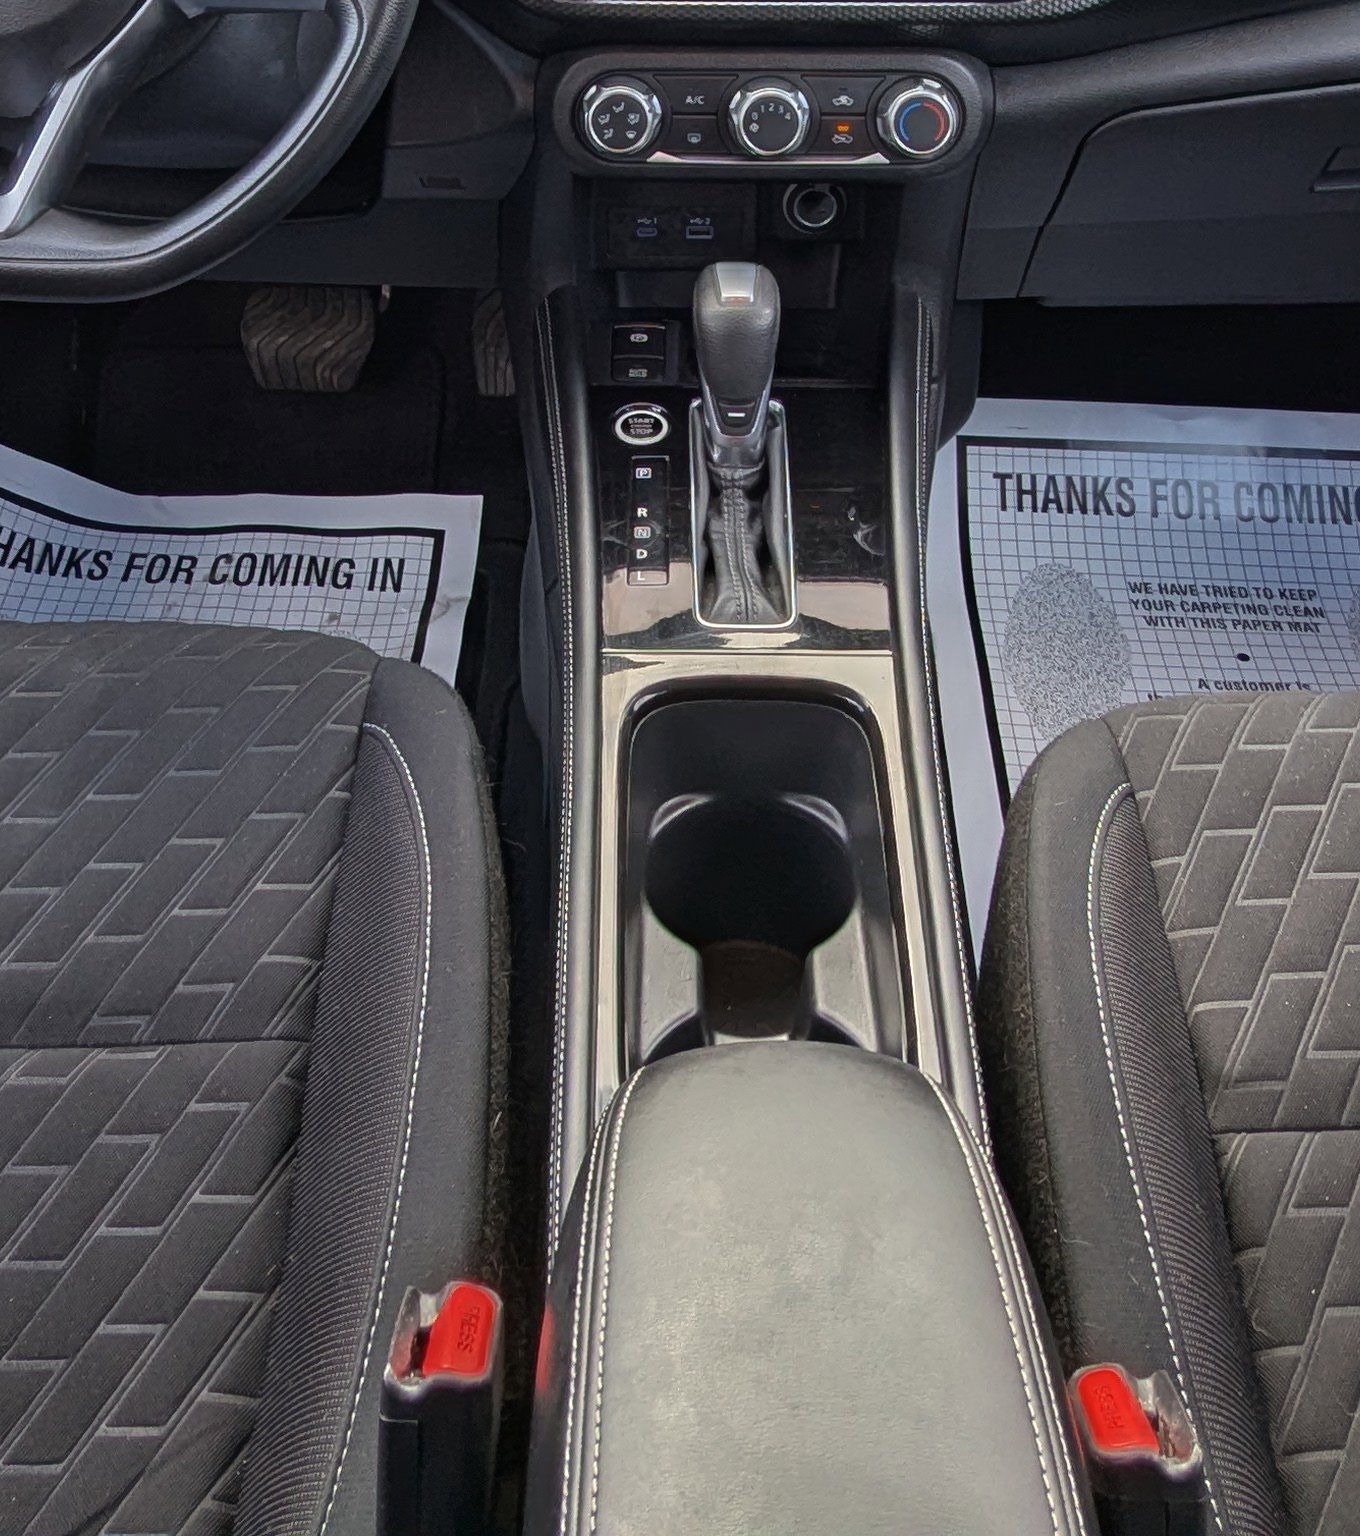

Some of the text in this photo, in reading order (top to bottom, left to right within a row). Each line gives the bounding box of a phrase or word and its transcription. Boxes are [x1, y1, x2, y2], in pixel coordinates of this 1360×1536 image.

[685, 95, 705, 105] A/C
[760, 104, 765, 113] 1
[768, 102, 775, 112] 2
[778, 105, 784, 113] 3
[784, 111, 791, 121] 4
[992, 471, 1137, 519] THANKS
[1150, 478, 1220, 522] FOR
[637, 507, 648, 518] R
[636, 549, 648, 559] D
[121, 551, 196, 585] FOR
[207, 552, 356, 592] COMING
[367, 555, 407, 593] IN
[637, 570, 646, 581] L
[1129, 580, 1318, 601] WE HAVE TRIED TO KEEP
[1130, 597, 1326, 620] YOUR CARPETING CLEAN
[1144, 615, 1323, 633] WITH THIS PAPER MAT
[1197, 678, 1210, 691] A
[1214, 679, 1291, 692] customer
